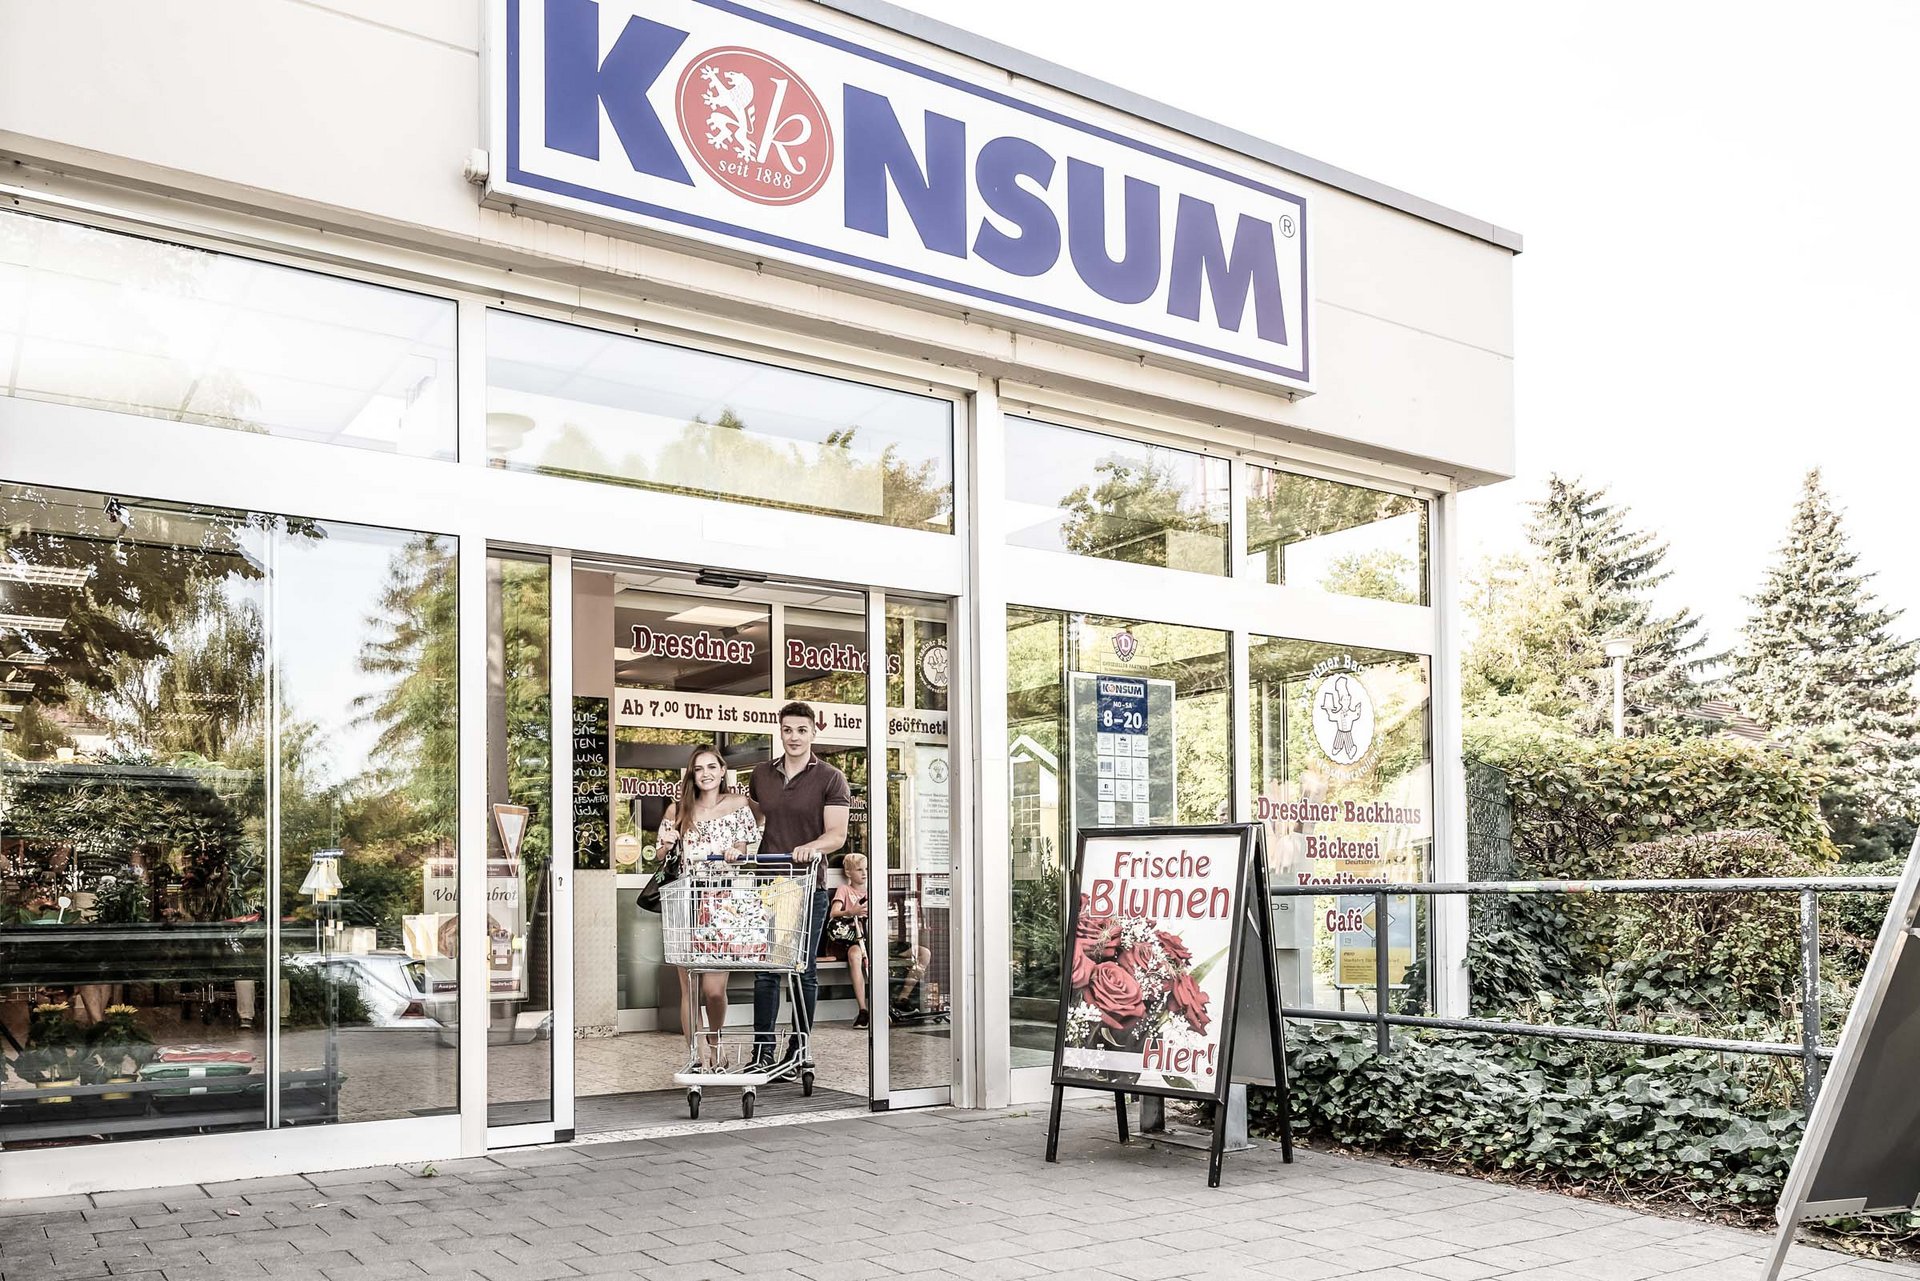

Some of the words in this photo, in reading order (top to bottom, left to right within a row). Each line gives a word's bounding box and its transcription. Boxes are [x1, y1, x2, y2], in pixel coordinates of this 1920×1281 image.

[544, 0, 1288, 346] KONSUM
[718, 160, 750, 178] seit
[755, 166, 792, 189] 1888
[631, 625, 754, 664] Dresdner
[787, 639, 901, 676] Backhs
[1102, 683, 1142, 696] KONSUM
[621, 698, 644, 717] Ab
[650, 700, 679, 718] 7.00
[684, 703, 713, 720] Uhr
[718, 704, 738, 722] ist
[834, 713, 862, 729] hier
[620, 776, 683, 801] Montag
[1257, 797, 1338, 823] Dresdner
[1343, 799, 1422, 825] Backhaus
[1306, 835, 1381, 860] Bäckerei
[1113, 849, 1211, 880] Frische
[1088, 878, 1232, 920] Blumen
[1326, 908, 1363, 932] Café
[1142, 1037, 1217, 1077] Hier!
